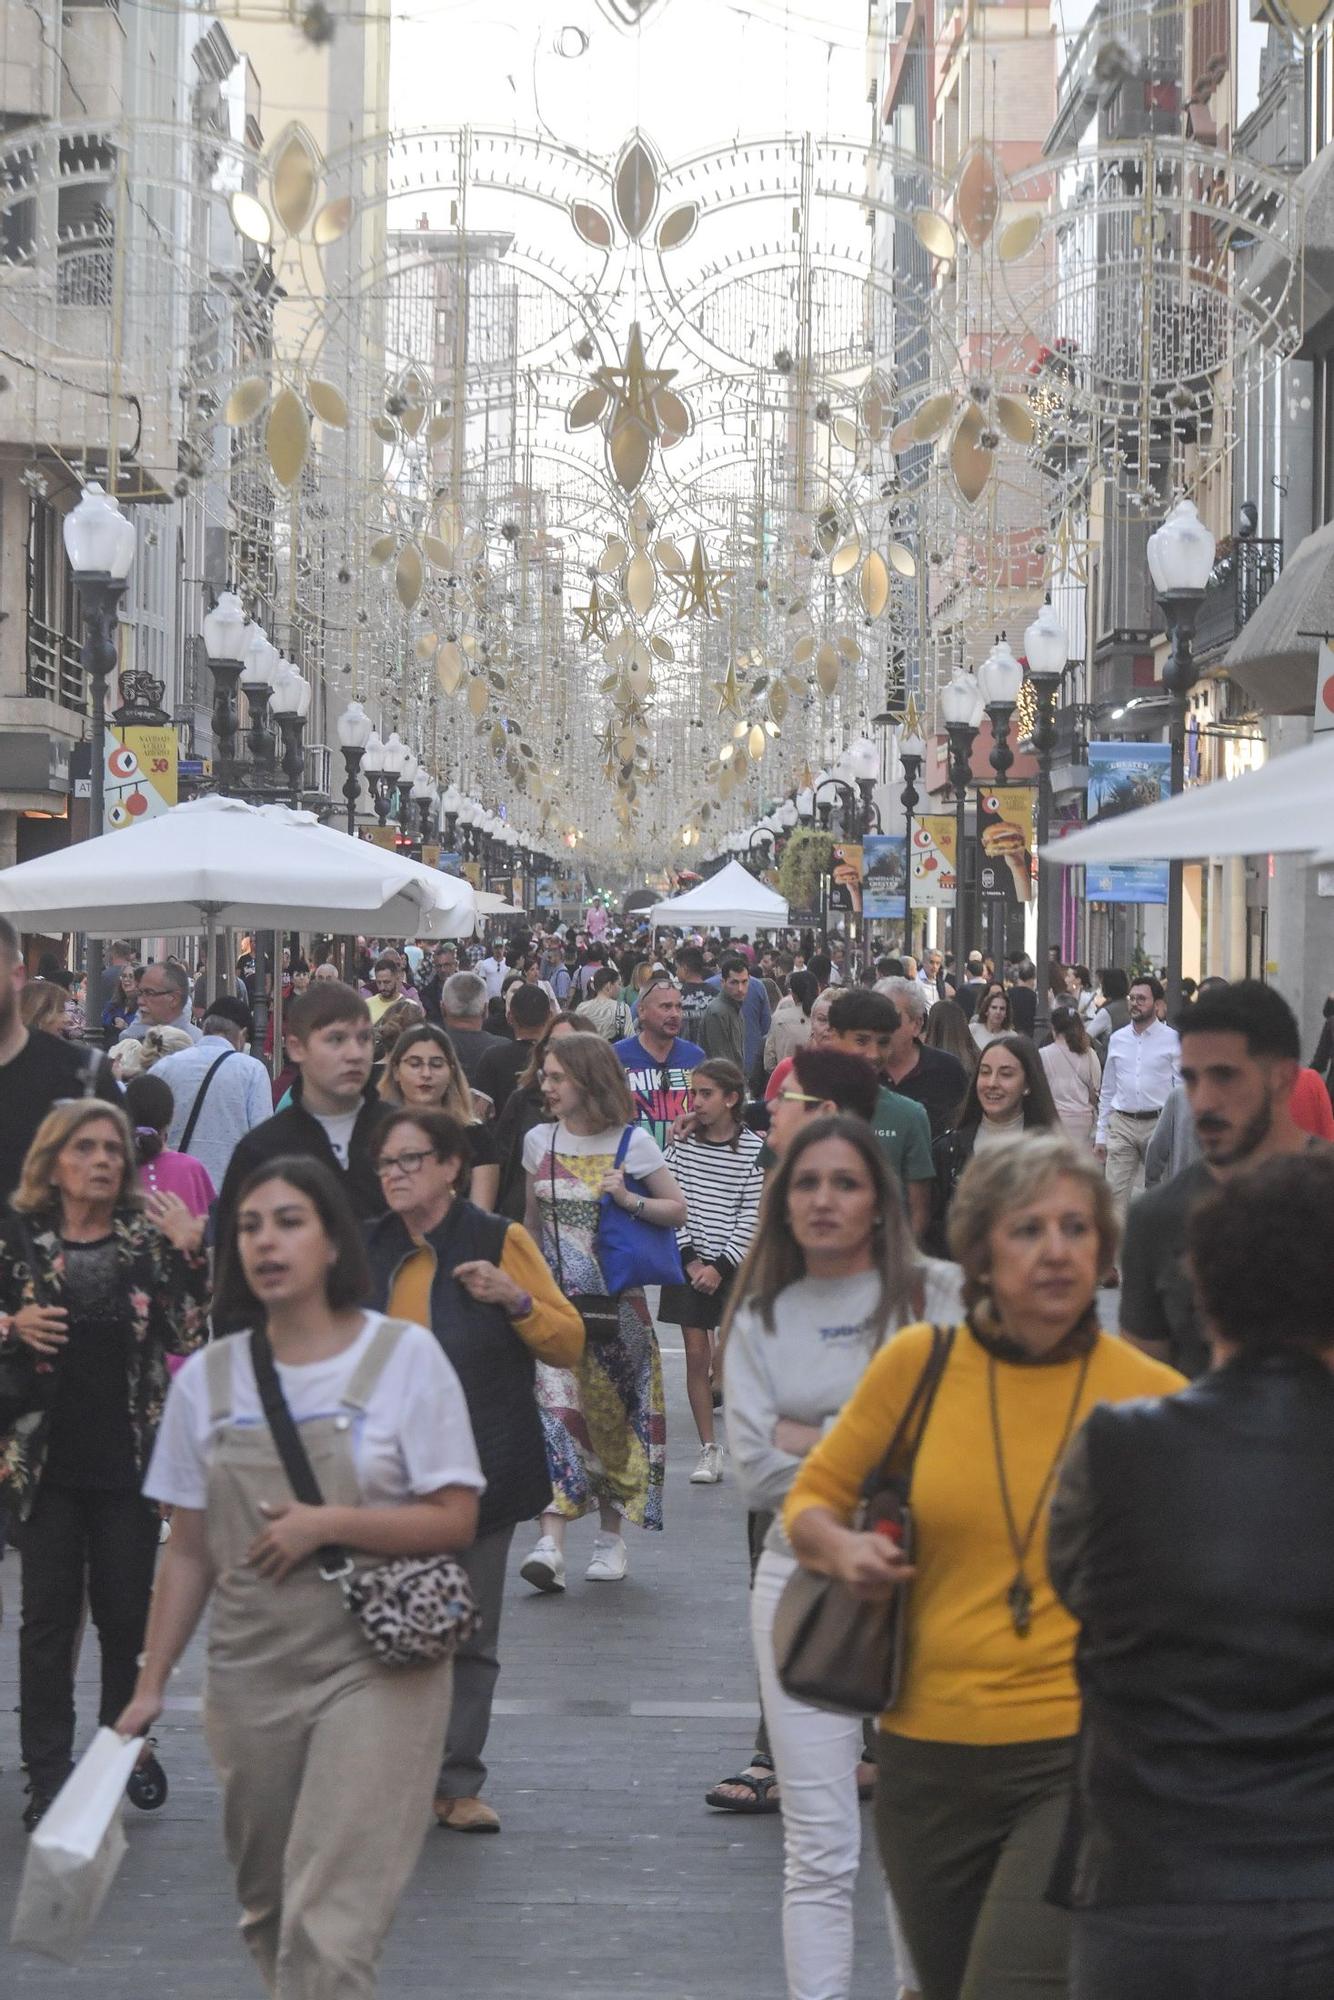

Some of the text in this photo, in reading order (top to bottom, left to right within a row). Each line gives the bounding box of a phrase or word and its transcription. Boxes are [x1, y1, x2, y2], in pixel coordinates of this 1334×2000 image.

[150, 758, 169, 773] 30
[628, 1068, 687, 1091] NIKE
[631, 1089, 694, 1121] NIK
